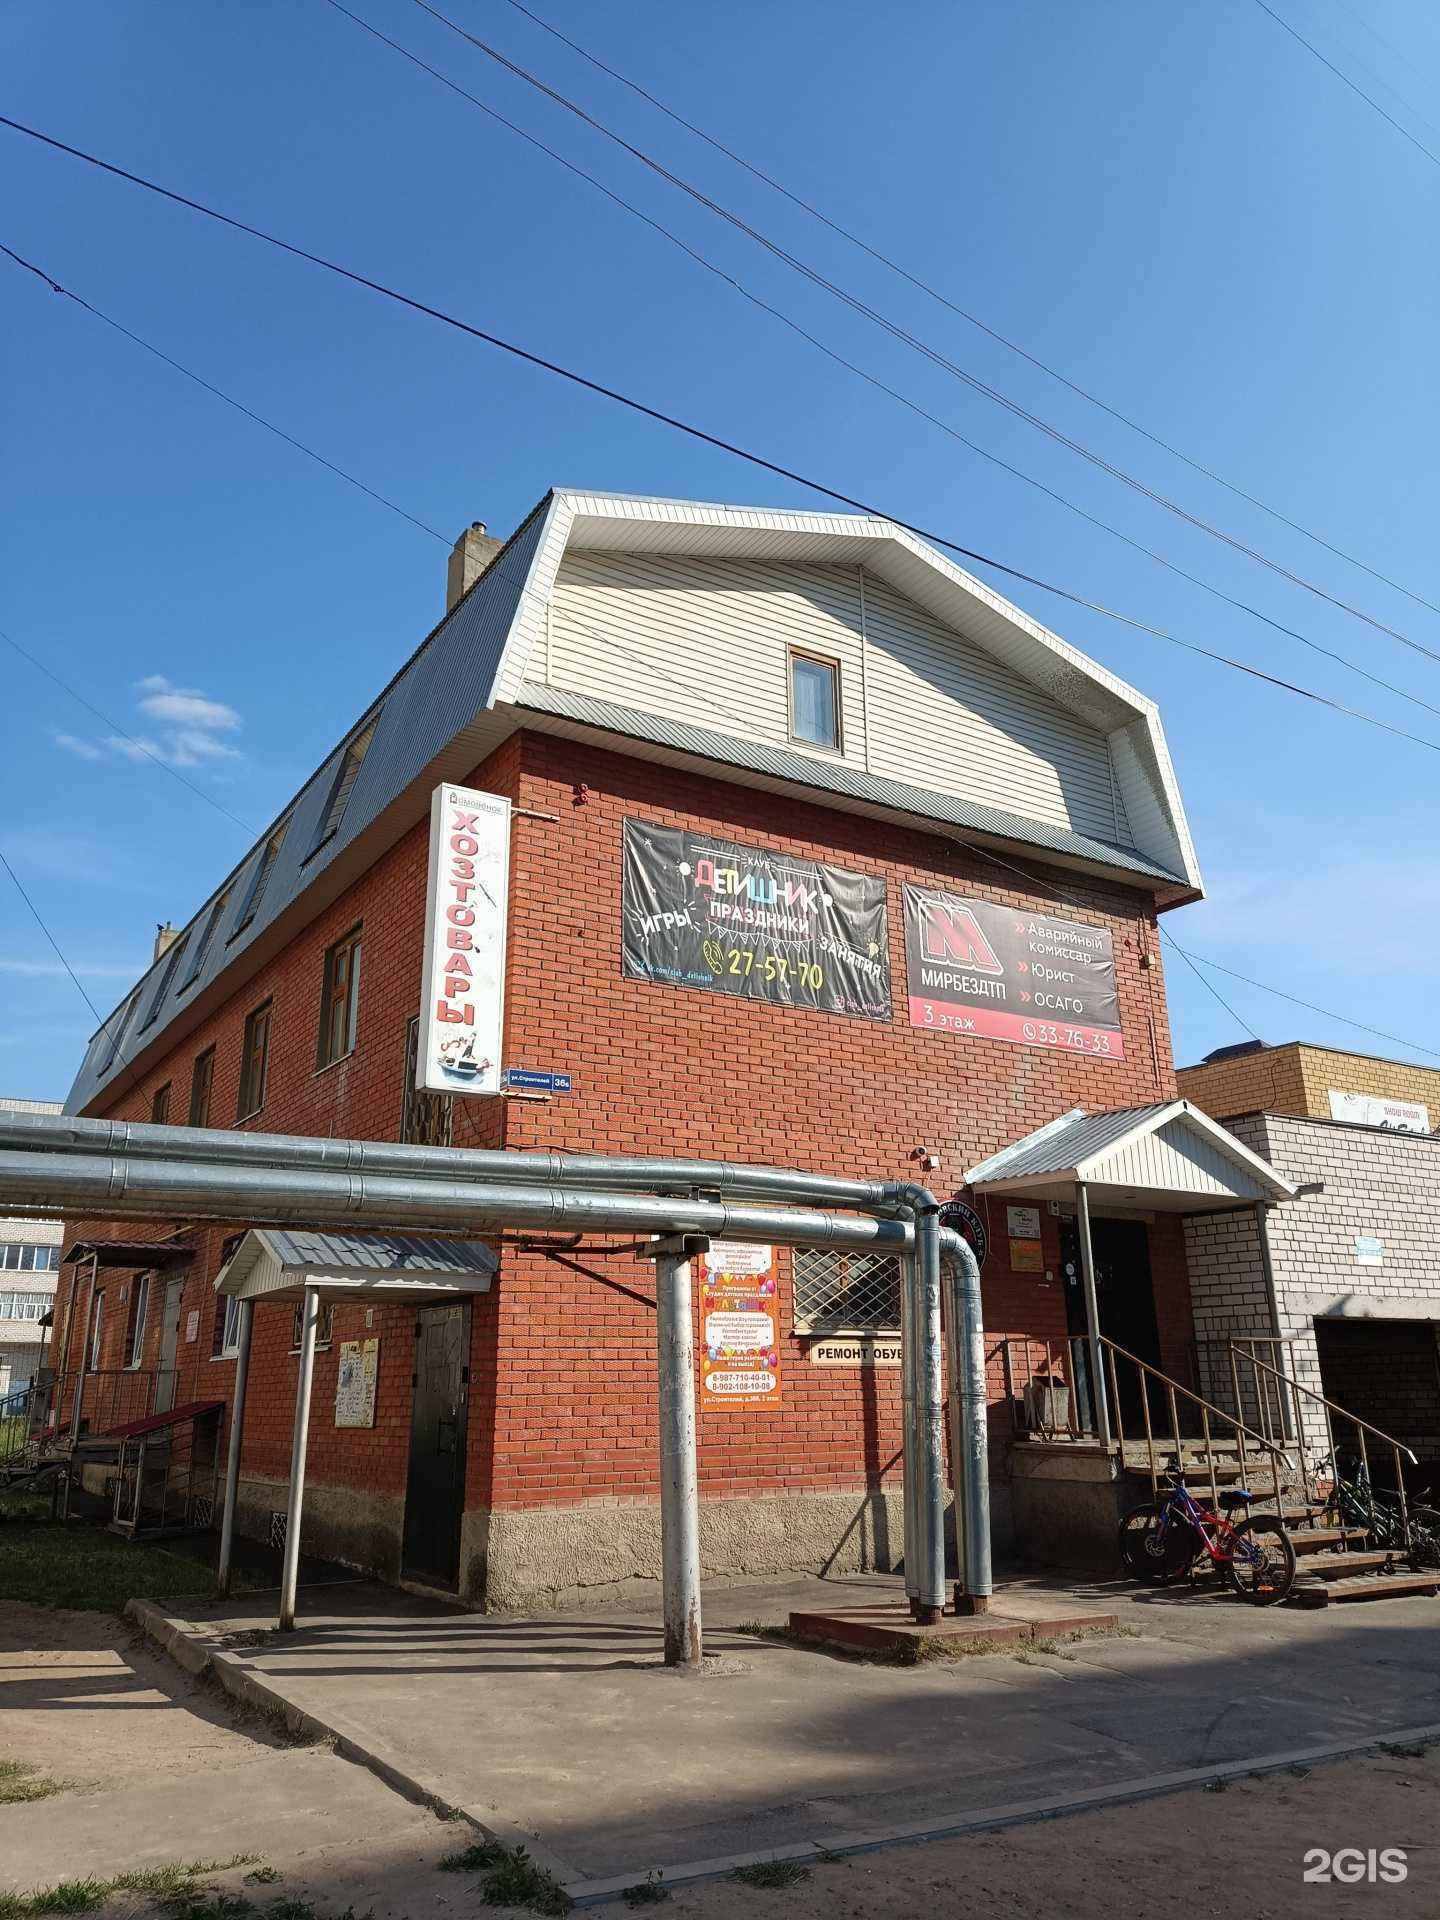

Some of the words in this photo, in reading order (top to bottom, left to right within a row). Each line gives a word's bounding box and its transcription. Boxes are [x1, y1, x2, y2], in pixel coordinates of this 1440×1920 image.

[748, 857, 771, 870] КЛУБ
[695, 859, 818, 914] ДЕТИШНИК
[436, 809, 480, 1027] ХОЗТОВАРЫ
[640, 908, 693, 937] ИГРЫ
[710, 901, 809, 935] ПРАЗДНИКИ
[1028, 922, 1104, 949] Аварийный
[819, 935, 882, 980] ЗАНЯТИЯ
[1029, 943, 1092, 965] комиссар
[728, 949, 824, 989] 27-57-70
[1031, 963, 1075, 984] Юрист
[921, 968, 1007, 1000] МИРБЕЗДТП
[923, 1004, 934, 1023] 3
[939, 1012, 976, 1031] этаж
[1034, 993, 1084, 1014] ОСАГО
[1038, 1024, 1111, 1053] 33-76-33
[818, 1348, 868, 1359] РЕМОНТ
